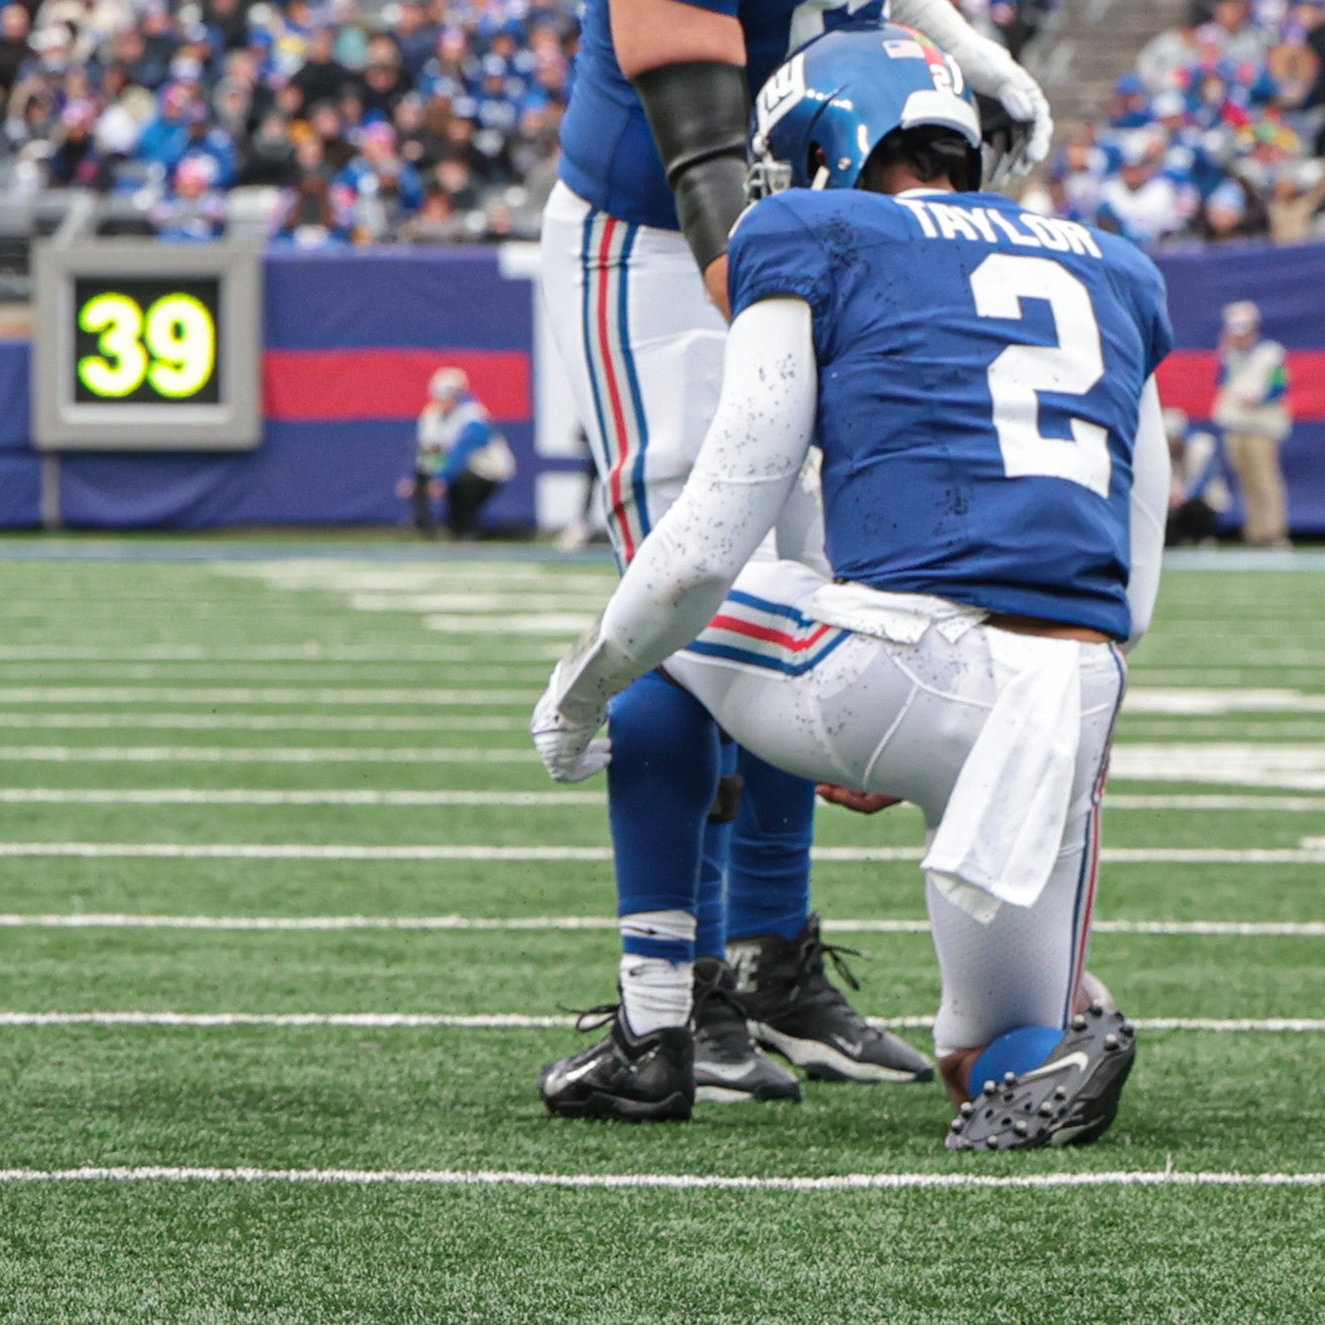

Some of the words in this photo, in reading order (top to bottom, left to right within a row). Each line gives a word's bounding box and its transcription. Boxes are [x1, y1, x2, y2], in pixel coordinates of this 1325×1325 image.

[893, 197, 1103, 259] TAYLOR
[78, 291, 216, 399] 39
[969, 253, 1112, 500] 2
